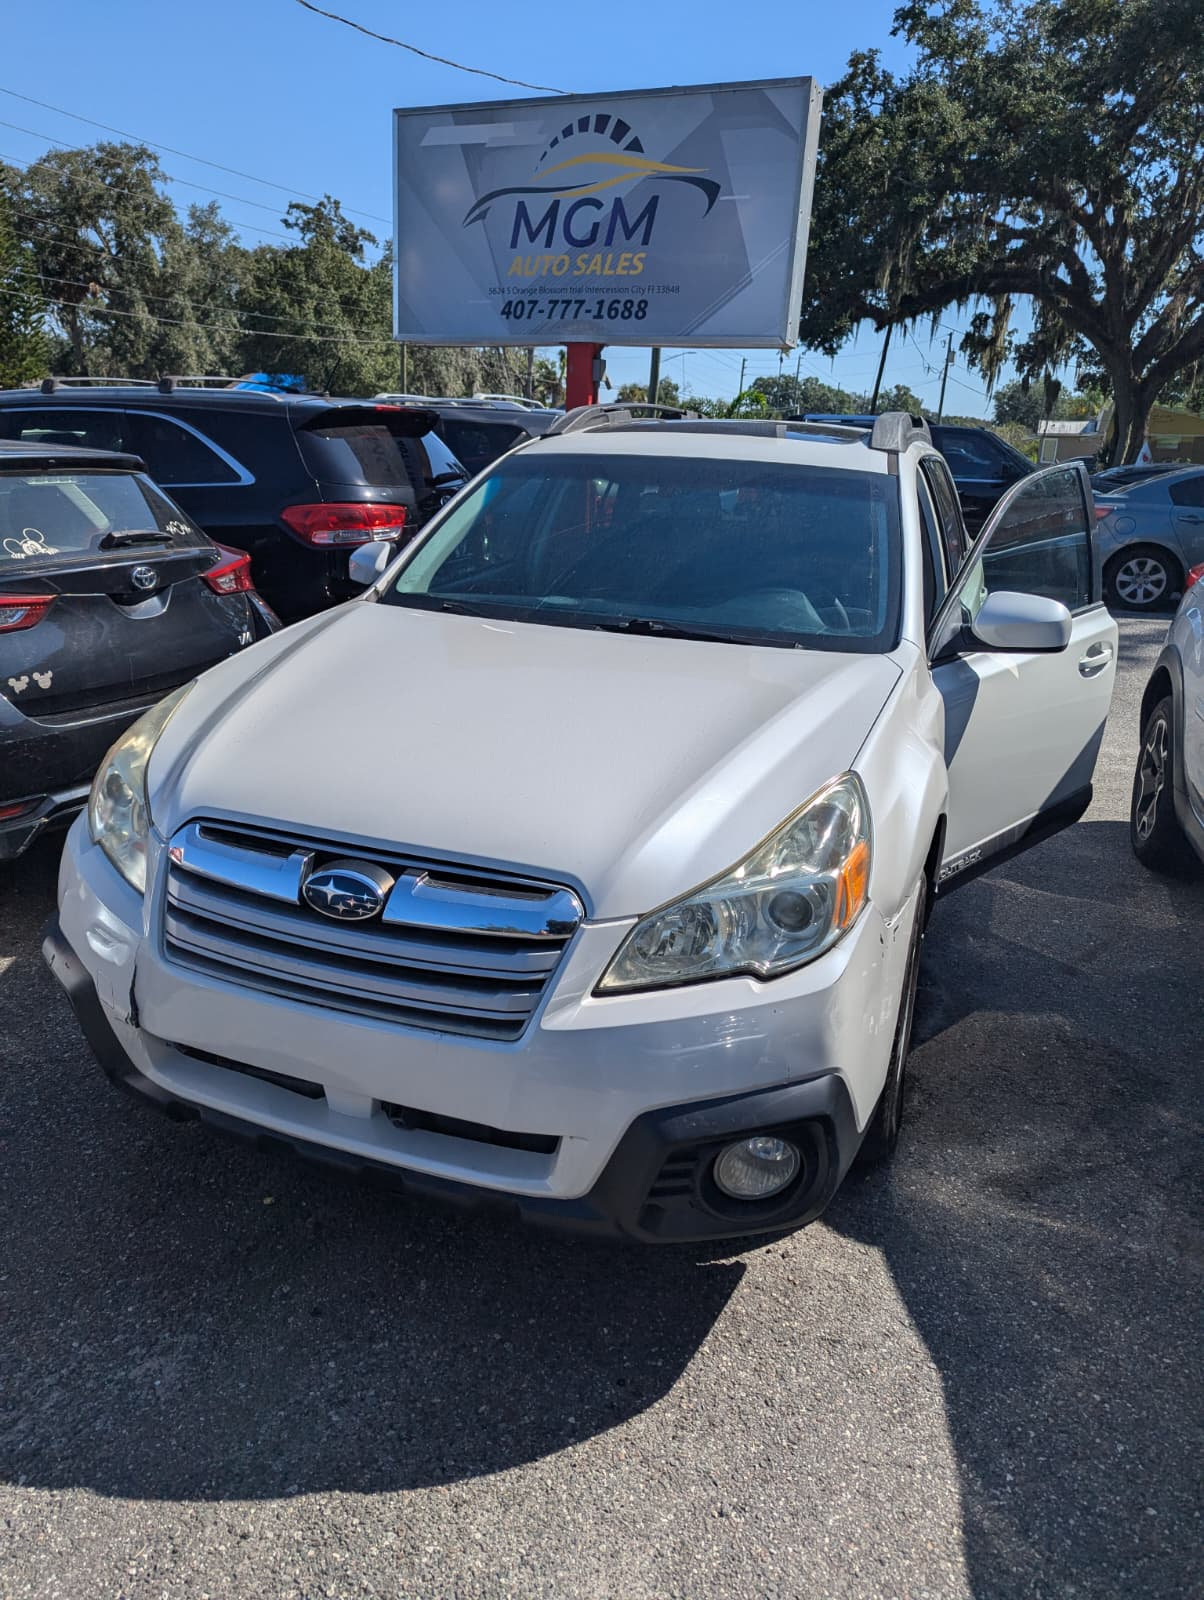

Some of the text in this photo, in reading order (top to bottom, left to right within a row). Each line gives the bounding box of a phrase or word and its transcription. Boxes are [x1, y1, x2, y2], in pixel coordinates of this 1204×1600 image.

[510, 195, 660, 249] MGM
[507, 252, 646, 277] AUTO SALES
[512, 286, 537, 296] Orange
[540, 286, 567, 295] Blossom
[631, 285, 647, 296] City
[500, 299, 648, 320] 407-777-1688
